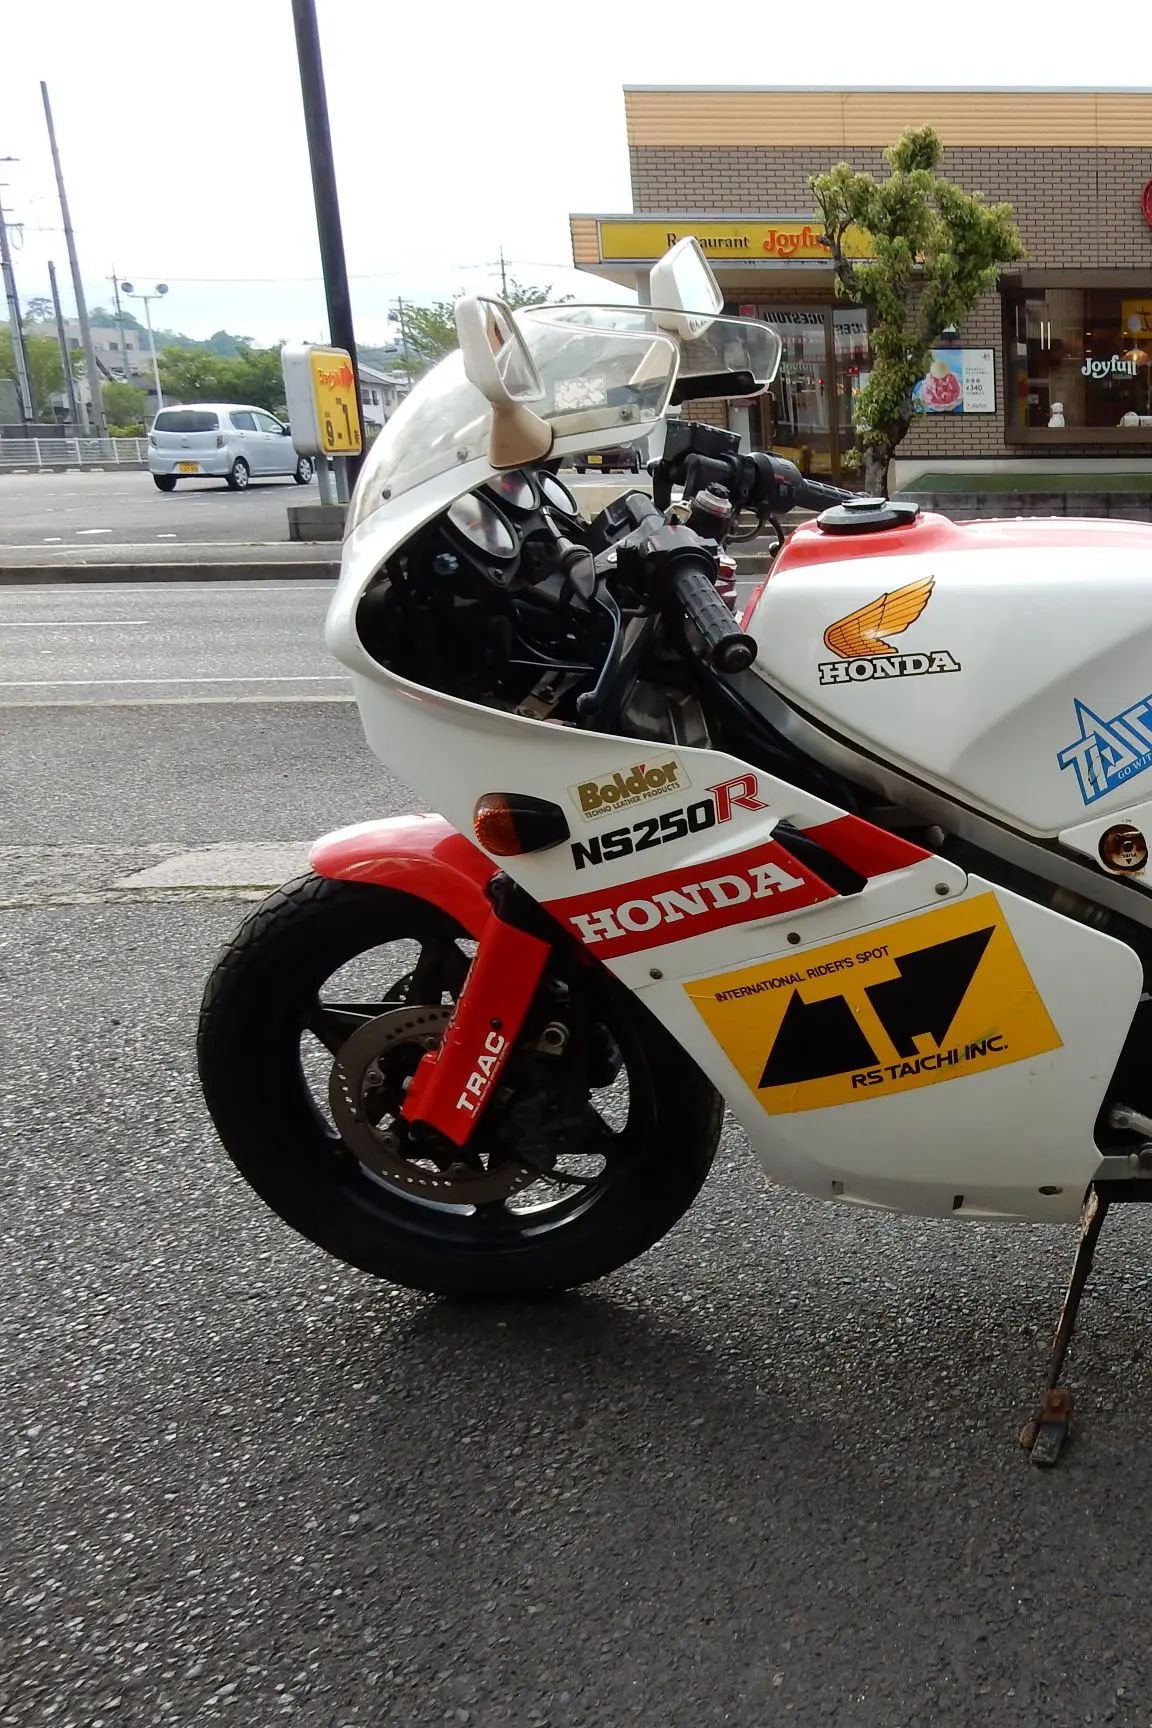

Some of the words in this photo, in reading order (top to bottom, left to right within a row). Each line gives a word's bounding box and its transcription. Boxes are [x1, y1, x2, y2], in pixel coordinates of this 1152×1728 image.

[667, 232, 749, 248] Raurant
[1081, 355, 1137, 378] Joyfull
[818, 650, 961, 685] HONDA
[1117, 767, 1132, 780] GO
[570, 773, 770, 870] NS250R
[585, 805, 611, 818] TECHNO
[613, 795, 641, 809] LEATHER
[642, 782, 680, 799] PRODUCTS
[569, 862, 806, 944] HONDA
[715, 972, 806, 1003] INTERNATIONAL
[806, 957, 854, 980] RIDER'S
[855, 945, 889, 964] SPOT
[456, 1031, 505, 1112] TRAC
[852, 1069, 883, 1088] RS
[885, 1049, 958, 1080] TAICHI
[964, 1035, 1008, 1061] INC.
